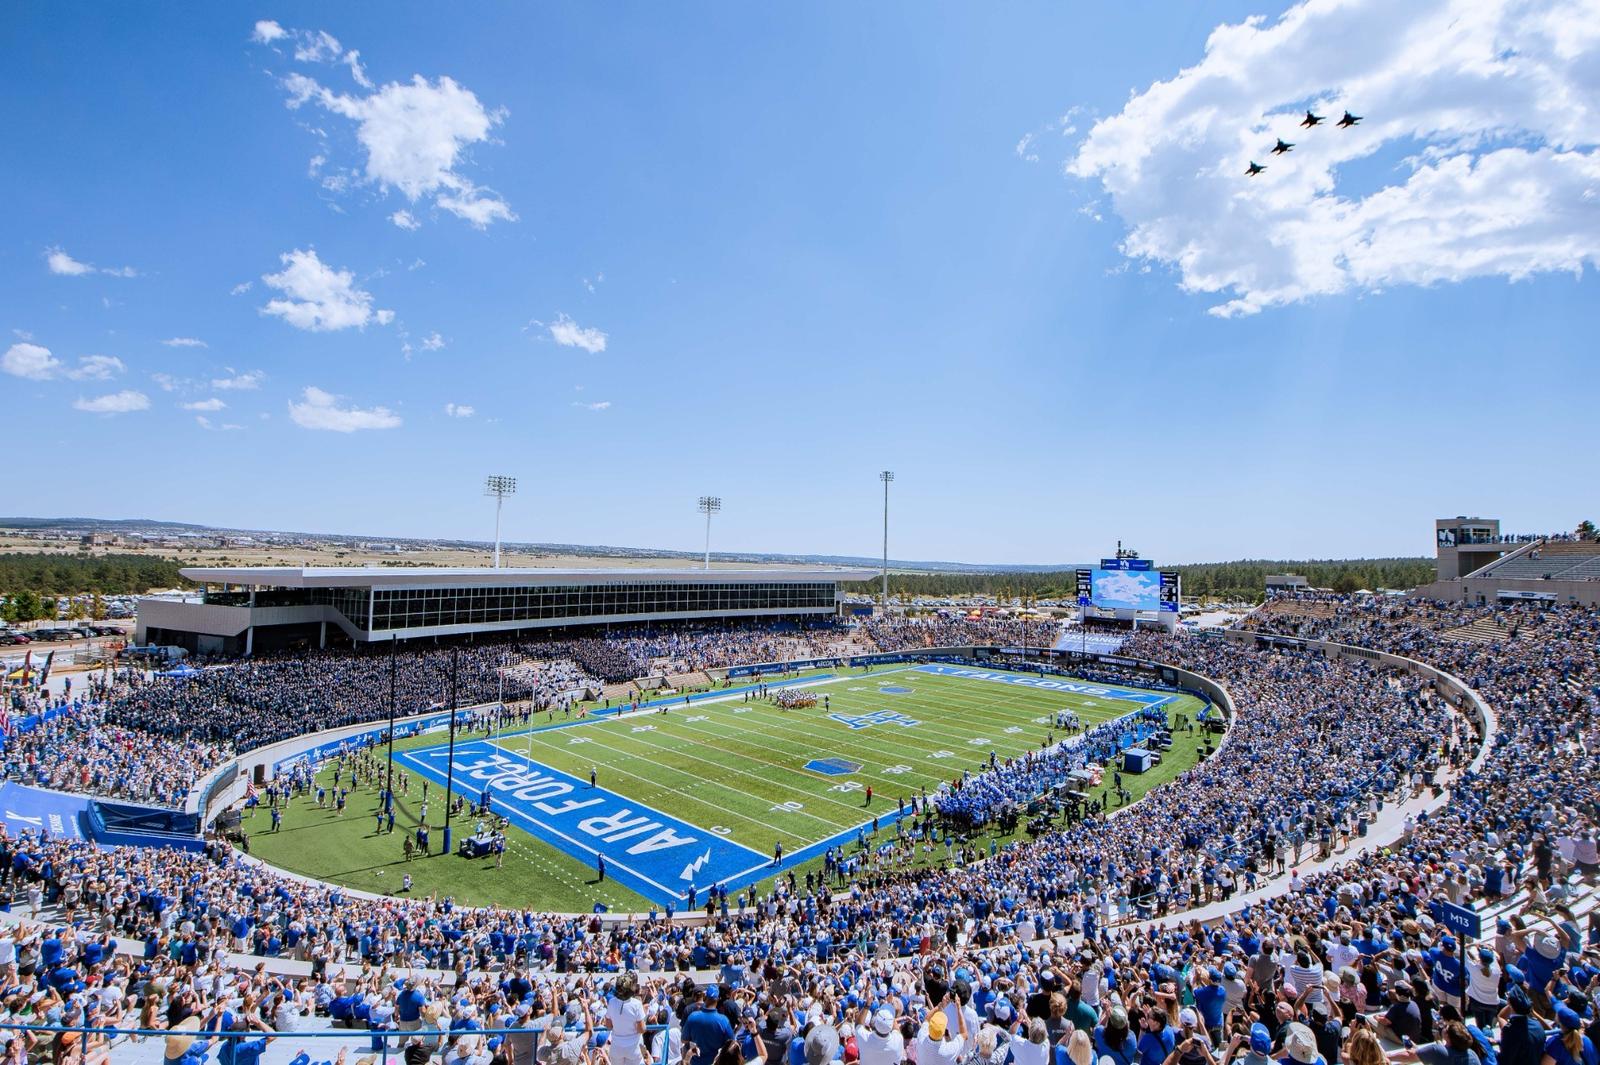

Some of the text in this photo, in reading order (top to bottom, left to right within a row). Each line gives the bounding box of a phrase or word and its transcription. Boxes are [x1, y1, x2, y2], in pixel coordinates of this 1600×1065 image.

[951, 670, 1110, 695] FALCONS
[449, 754, 697, 855] AIR FORCE
[1449, 911, 1470, 928] M13
[1435, 960, 1455, 984] AF
